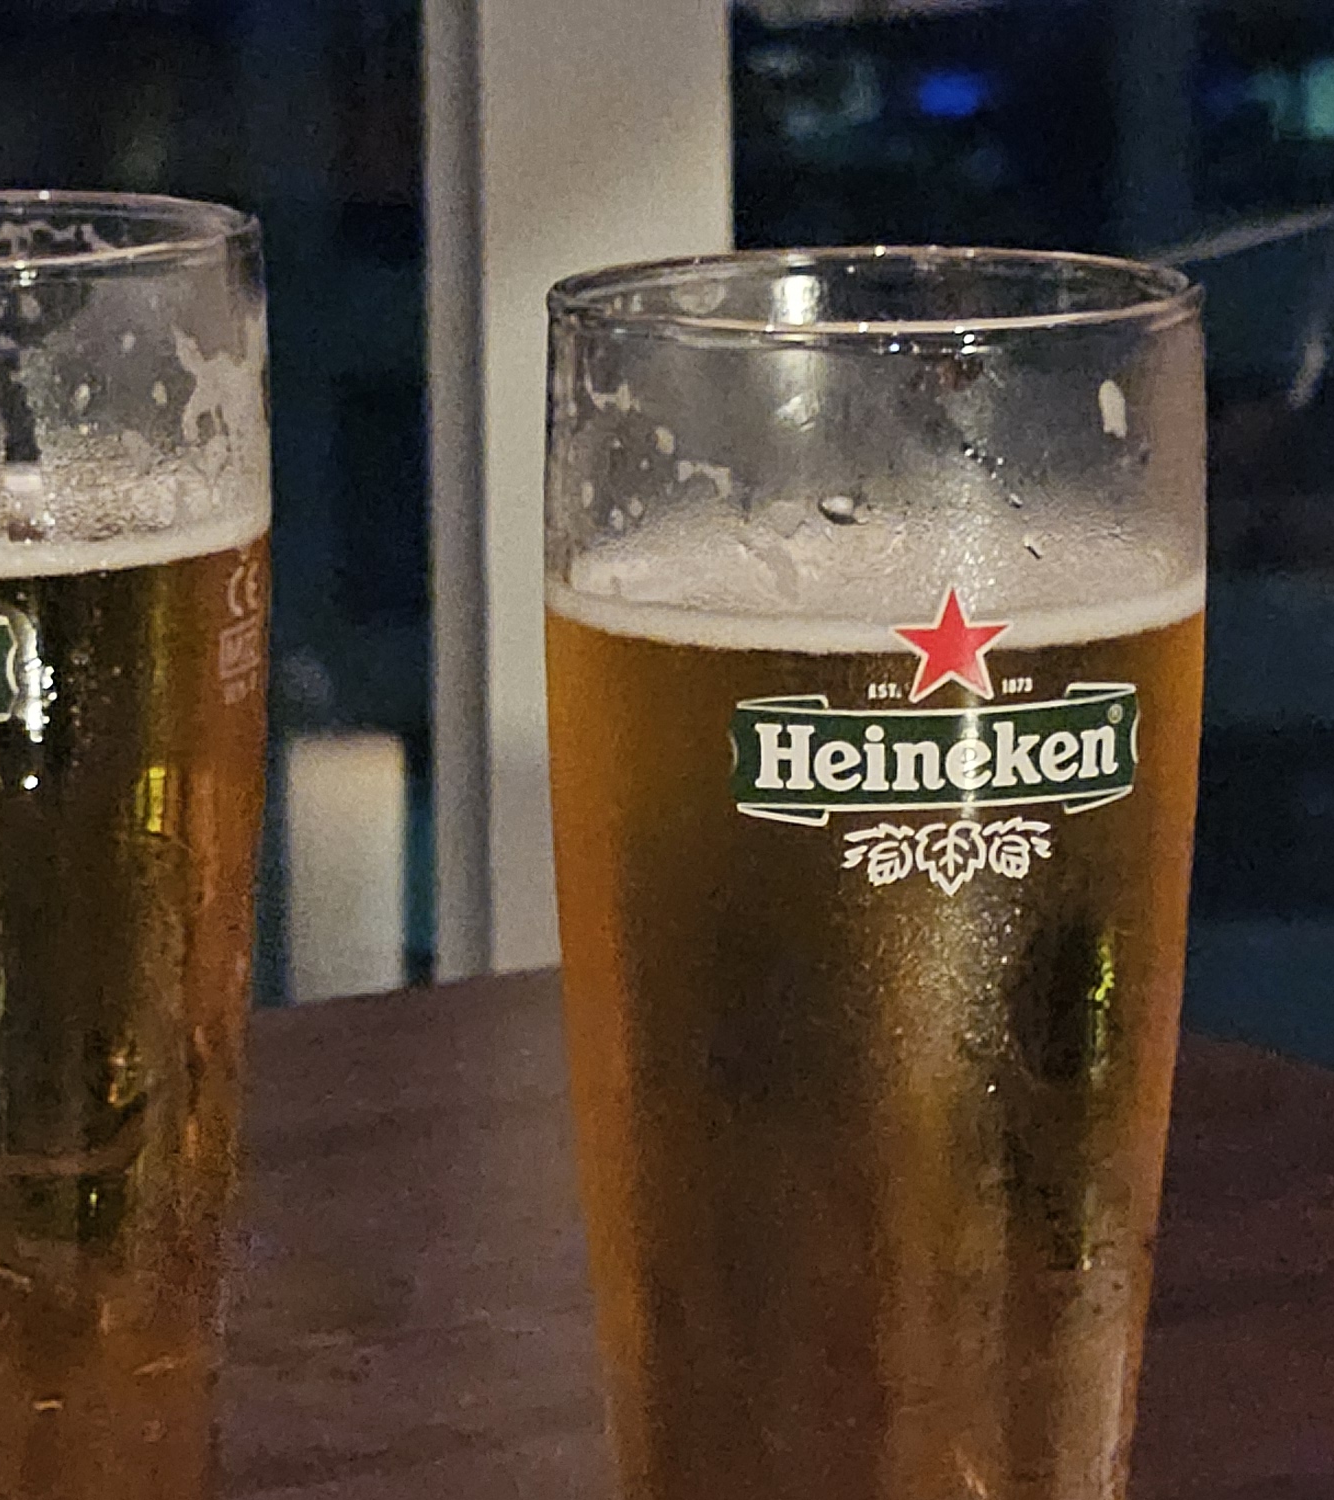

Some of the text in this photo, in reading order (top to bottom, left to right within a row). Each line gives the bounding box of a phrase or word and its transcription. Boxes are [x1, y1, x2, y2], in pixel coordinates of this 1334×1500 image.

[867, 676, 1034, 700] EST. 1873
[754, 721, 1120, 793] Heineken
